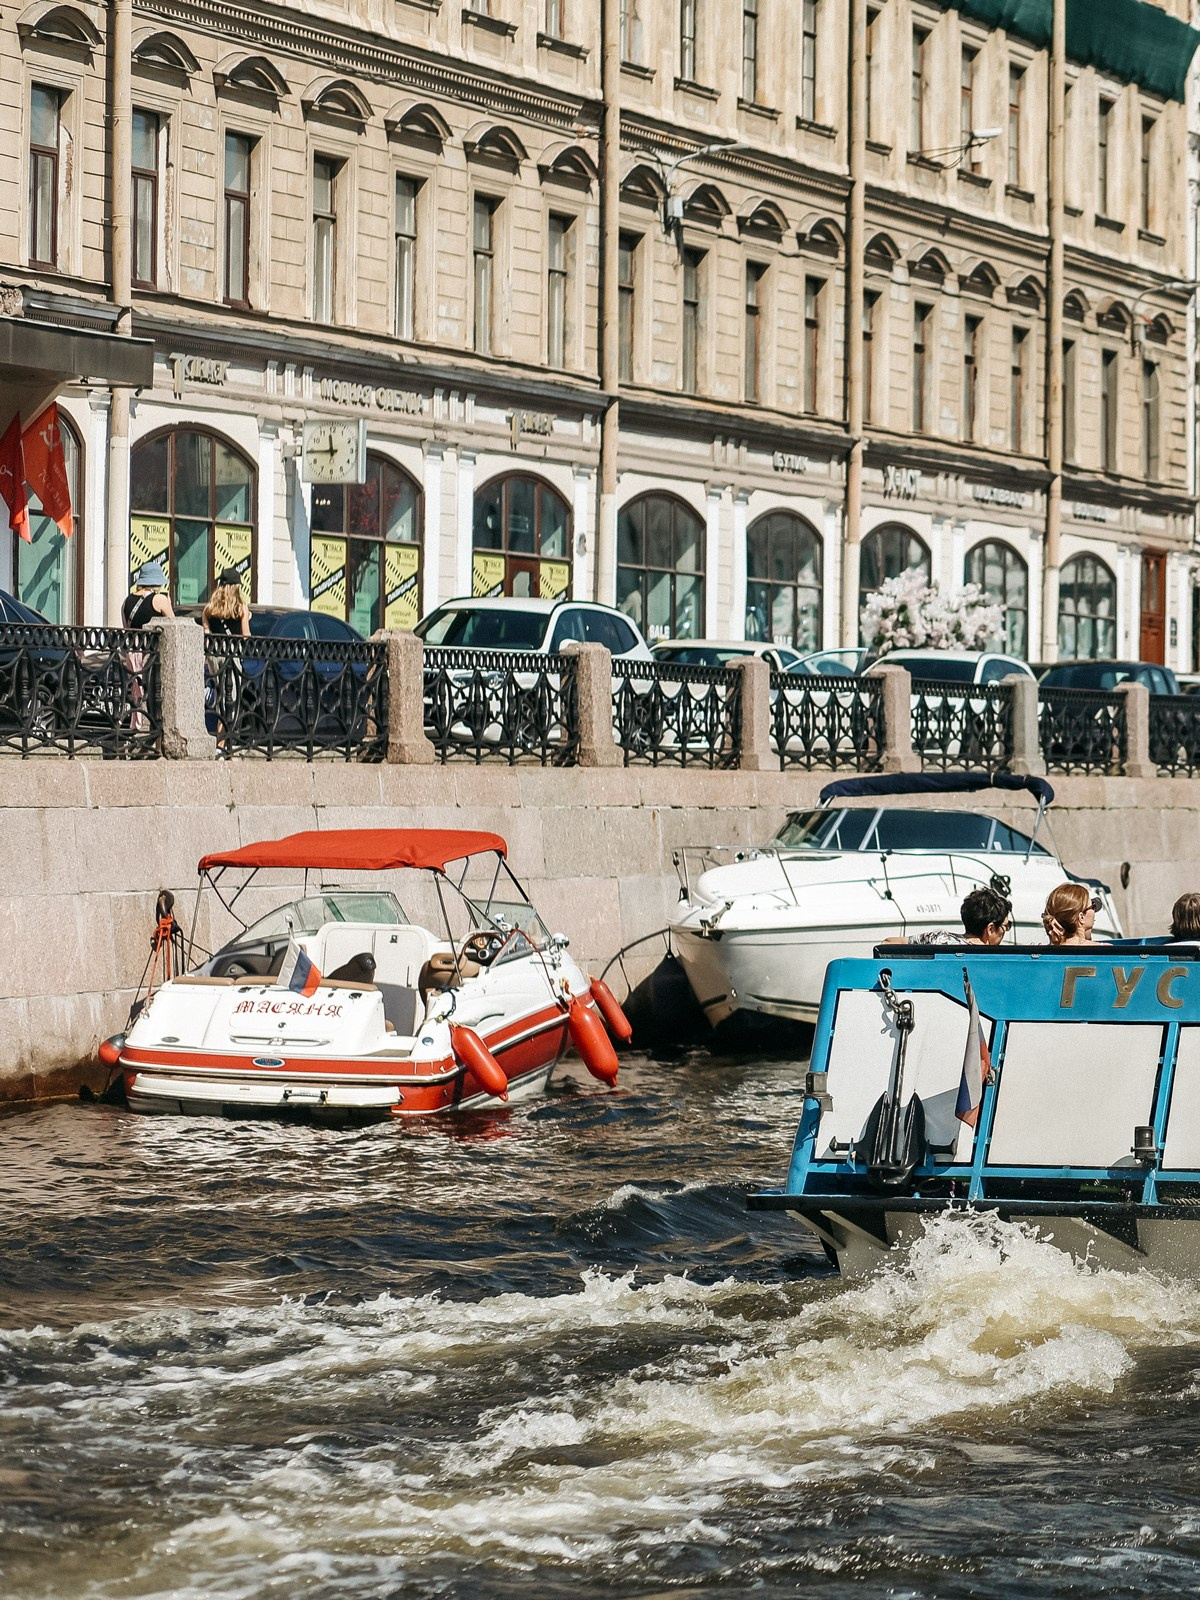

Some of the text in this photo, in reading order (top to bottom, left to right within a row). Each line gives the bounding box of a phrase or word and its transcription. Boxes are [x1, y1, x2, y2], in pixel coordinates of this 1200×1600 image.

[320, 378, 424, 413] МОДНАЯ ОДЕЖДА
[773, 451, 808, 471] БУТИК
[649, 624, 671, 639] SALE
[233, 1000, 344, 1018] МАСЯНЯ
